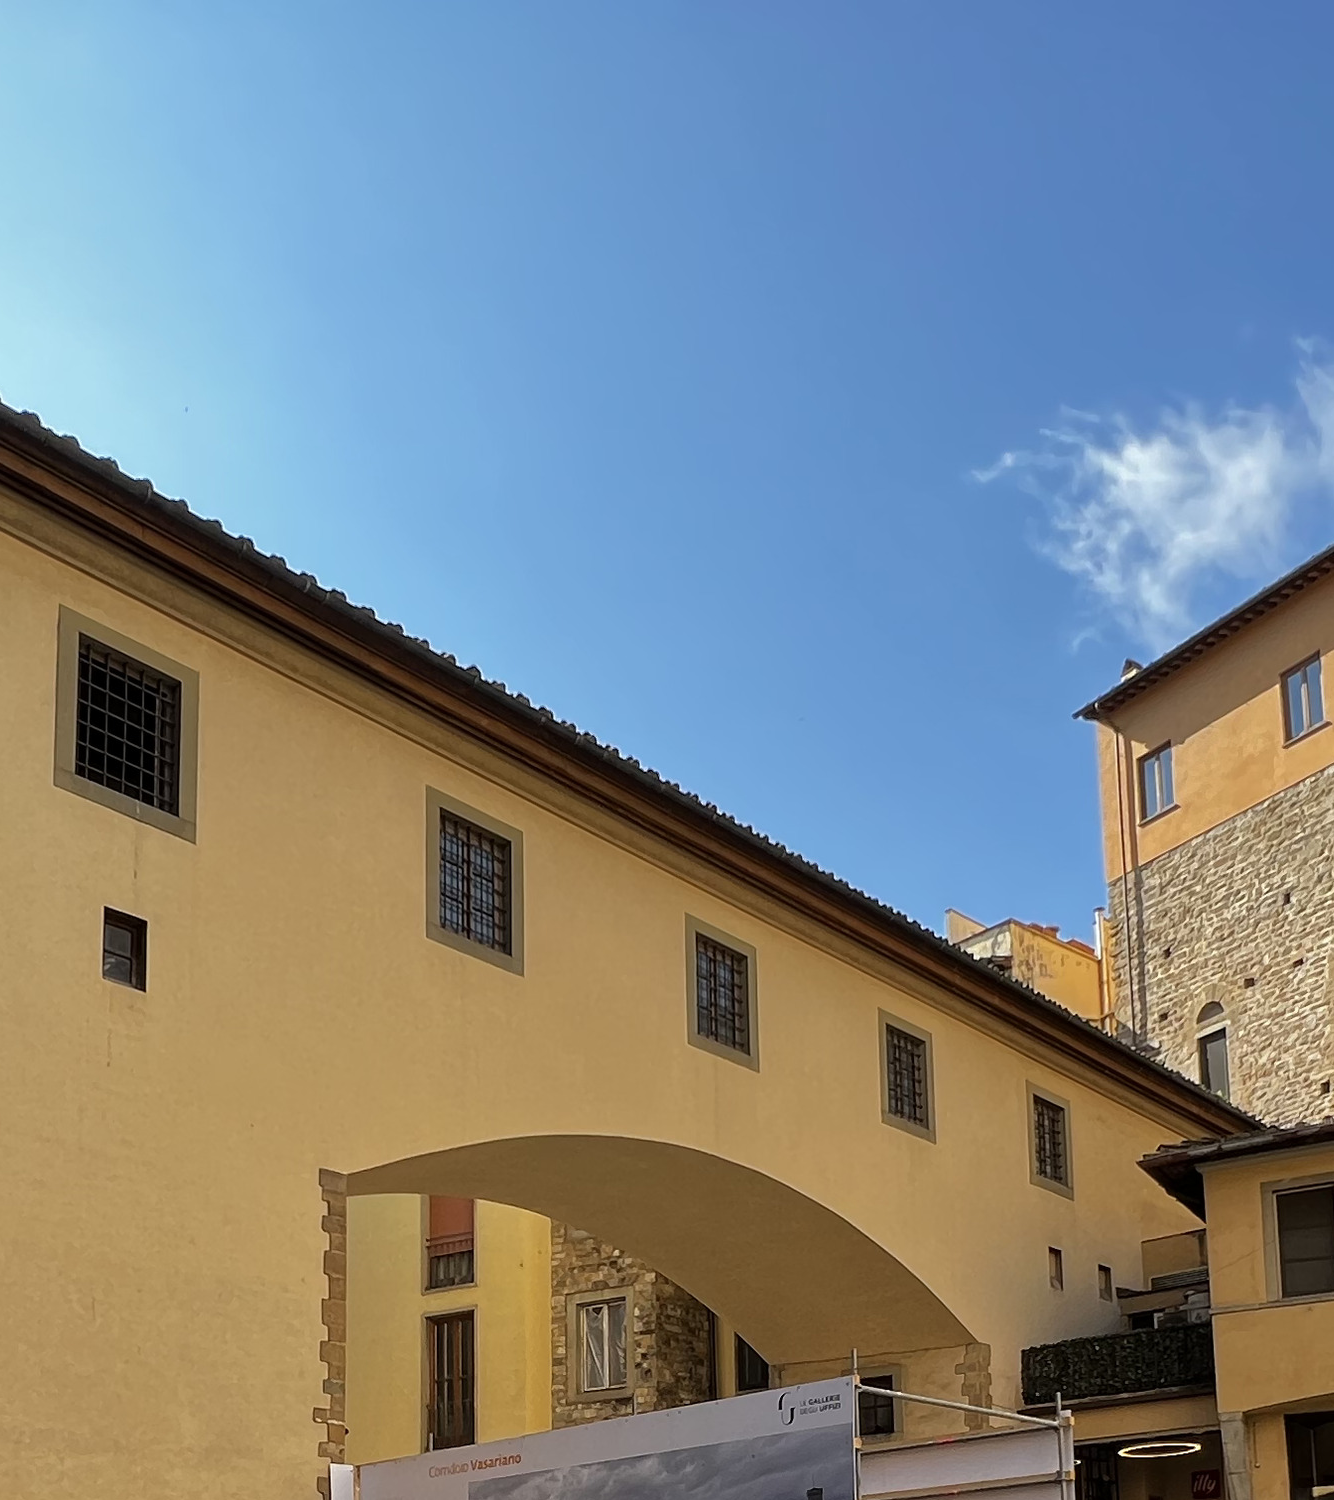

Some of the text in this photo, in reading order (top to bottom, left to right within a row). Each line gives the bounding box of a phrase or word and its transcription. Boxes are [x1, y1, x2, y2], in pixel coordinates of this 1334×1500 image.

[808, 1394, 841, 1405] GALLERIE
[819, 1402, 841, 1412] UFFIZI
[470, 1453, 522, 1471] Vasariano
[1193, 1474, 1216, 1495] illy
